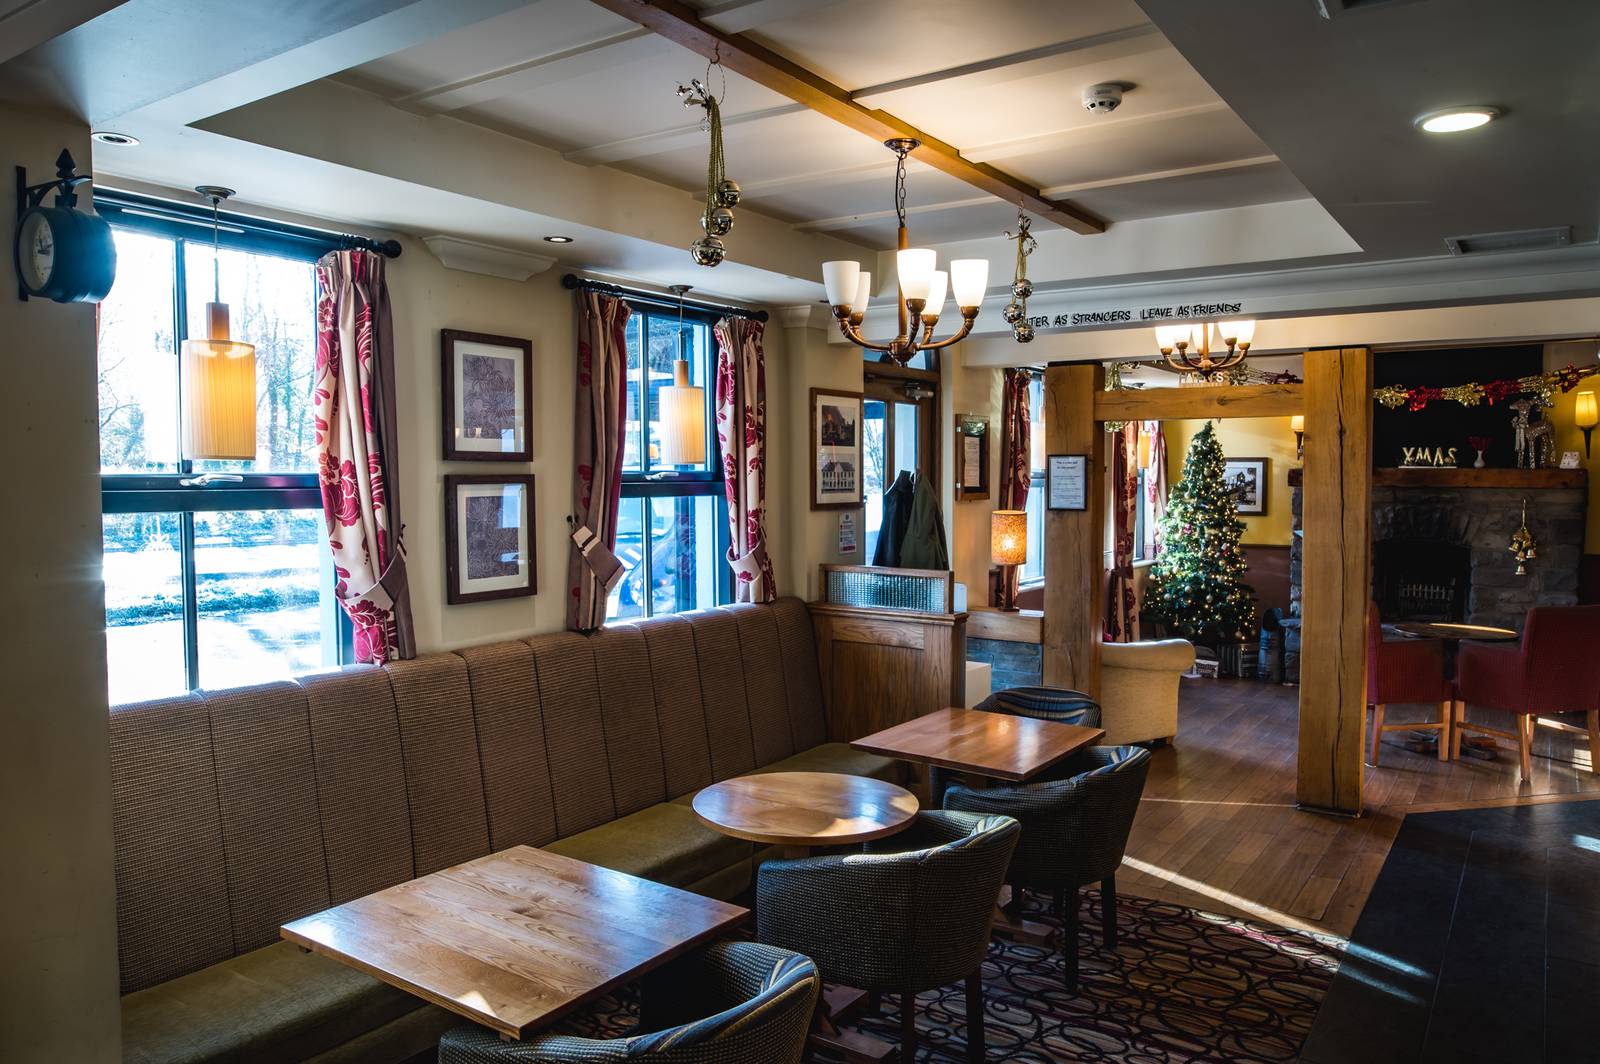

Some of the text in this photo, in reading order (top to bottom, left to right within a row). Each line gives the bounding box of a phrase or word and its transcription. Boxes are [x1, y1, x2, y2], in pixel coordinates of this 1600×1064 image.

[1055, 315, 1068, 326] AS
[1142, 308, 1172, 320] LEAVE
[1177, 305, 1190, 317] AS
[1193, 303, 1242, 315] FRIENDS
[1402, 447, 1459, 466] XMAS
